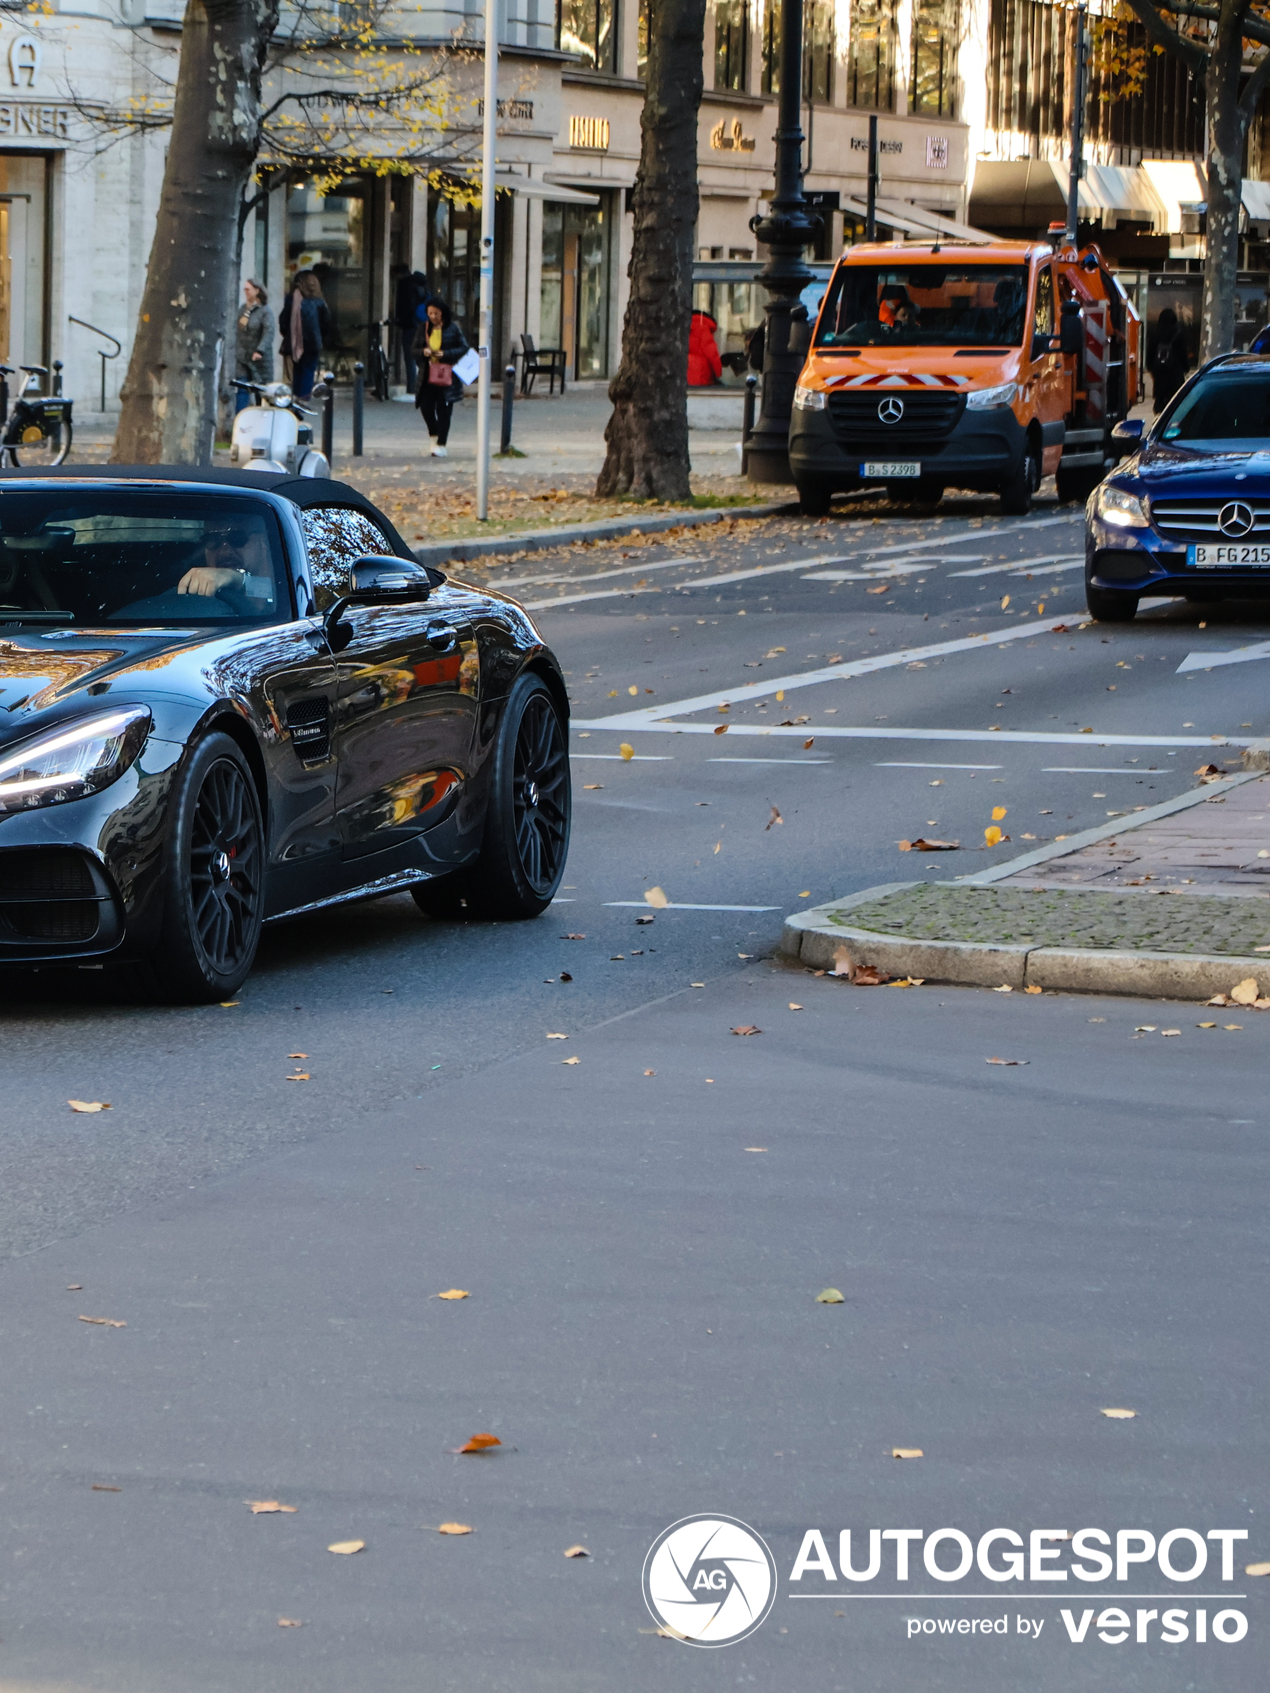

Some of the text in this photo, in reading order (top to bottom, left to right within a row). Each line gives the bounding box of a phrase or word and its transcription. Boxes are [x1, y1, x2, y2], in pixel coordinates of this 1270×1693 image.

[868, 464, 916, 475] B S 2398
[1196, 547, 1206, 562] B
[1217, 547, 1237, 562] FG
